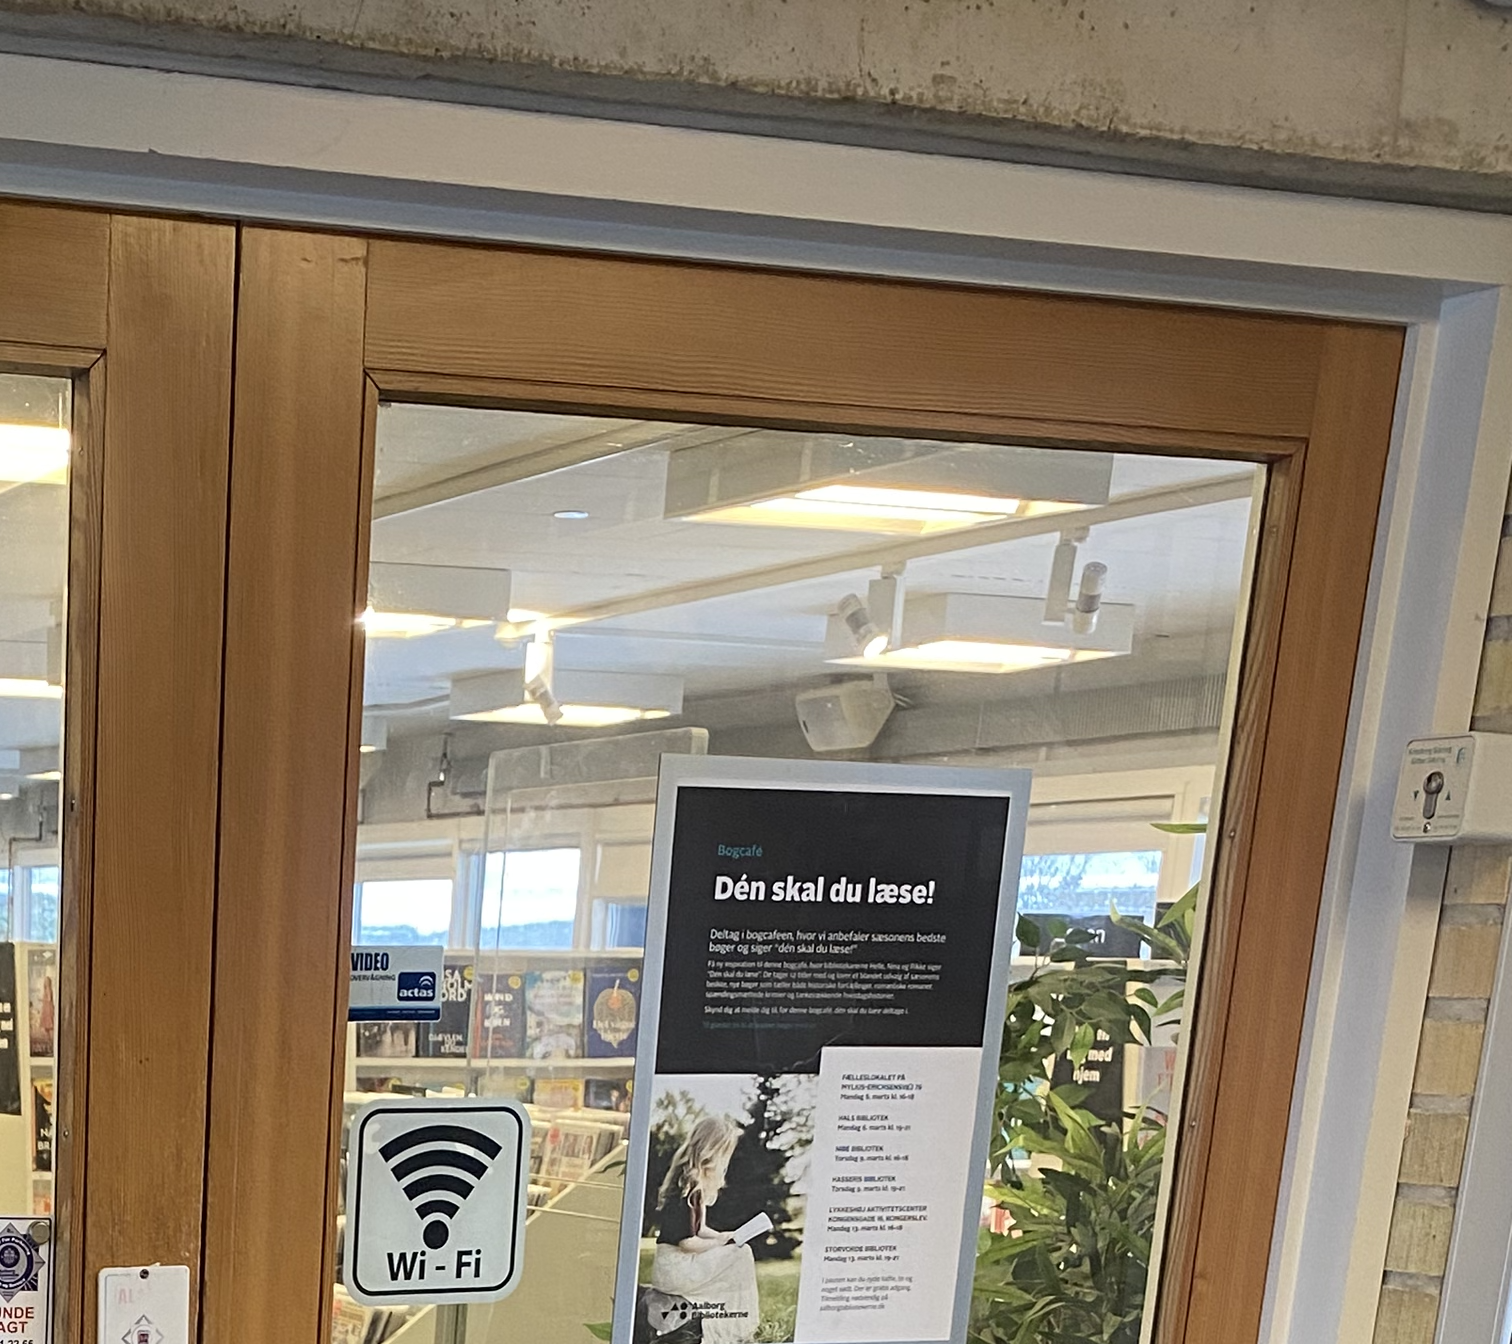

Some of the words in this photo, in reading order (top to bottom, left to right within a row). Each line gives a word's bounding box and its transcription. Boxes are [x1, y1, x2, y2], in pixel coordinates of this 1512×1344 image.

[717, 844, 763, 858] Bogcafé
[714, 874, 766, 901] Dén
[771, 875, 824, 901] skal
[829, 876, 862, 902] du
[868, 877, 935, 904] læse!
[710, 929, 739, 942] Deltag
[796, 930, 816, 940] hvor
[818, 932, 826, 941] vi
[828, 930, 869, 942] anbefaler
[871, 933, 915, 943] sæsonens
[916, 933, 947, 943] bedste
[709, 942, 736, 954] bøger
[738, 944, 749, 954] og
[751, 943, 772, 954] siger
[797, 943, 815, 953] skal
[816, 943, 827, 953] du
[351, 952, 389, 971] VIDEO
[399, 988, 434, 997] actas
